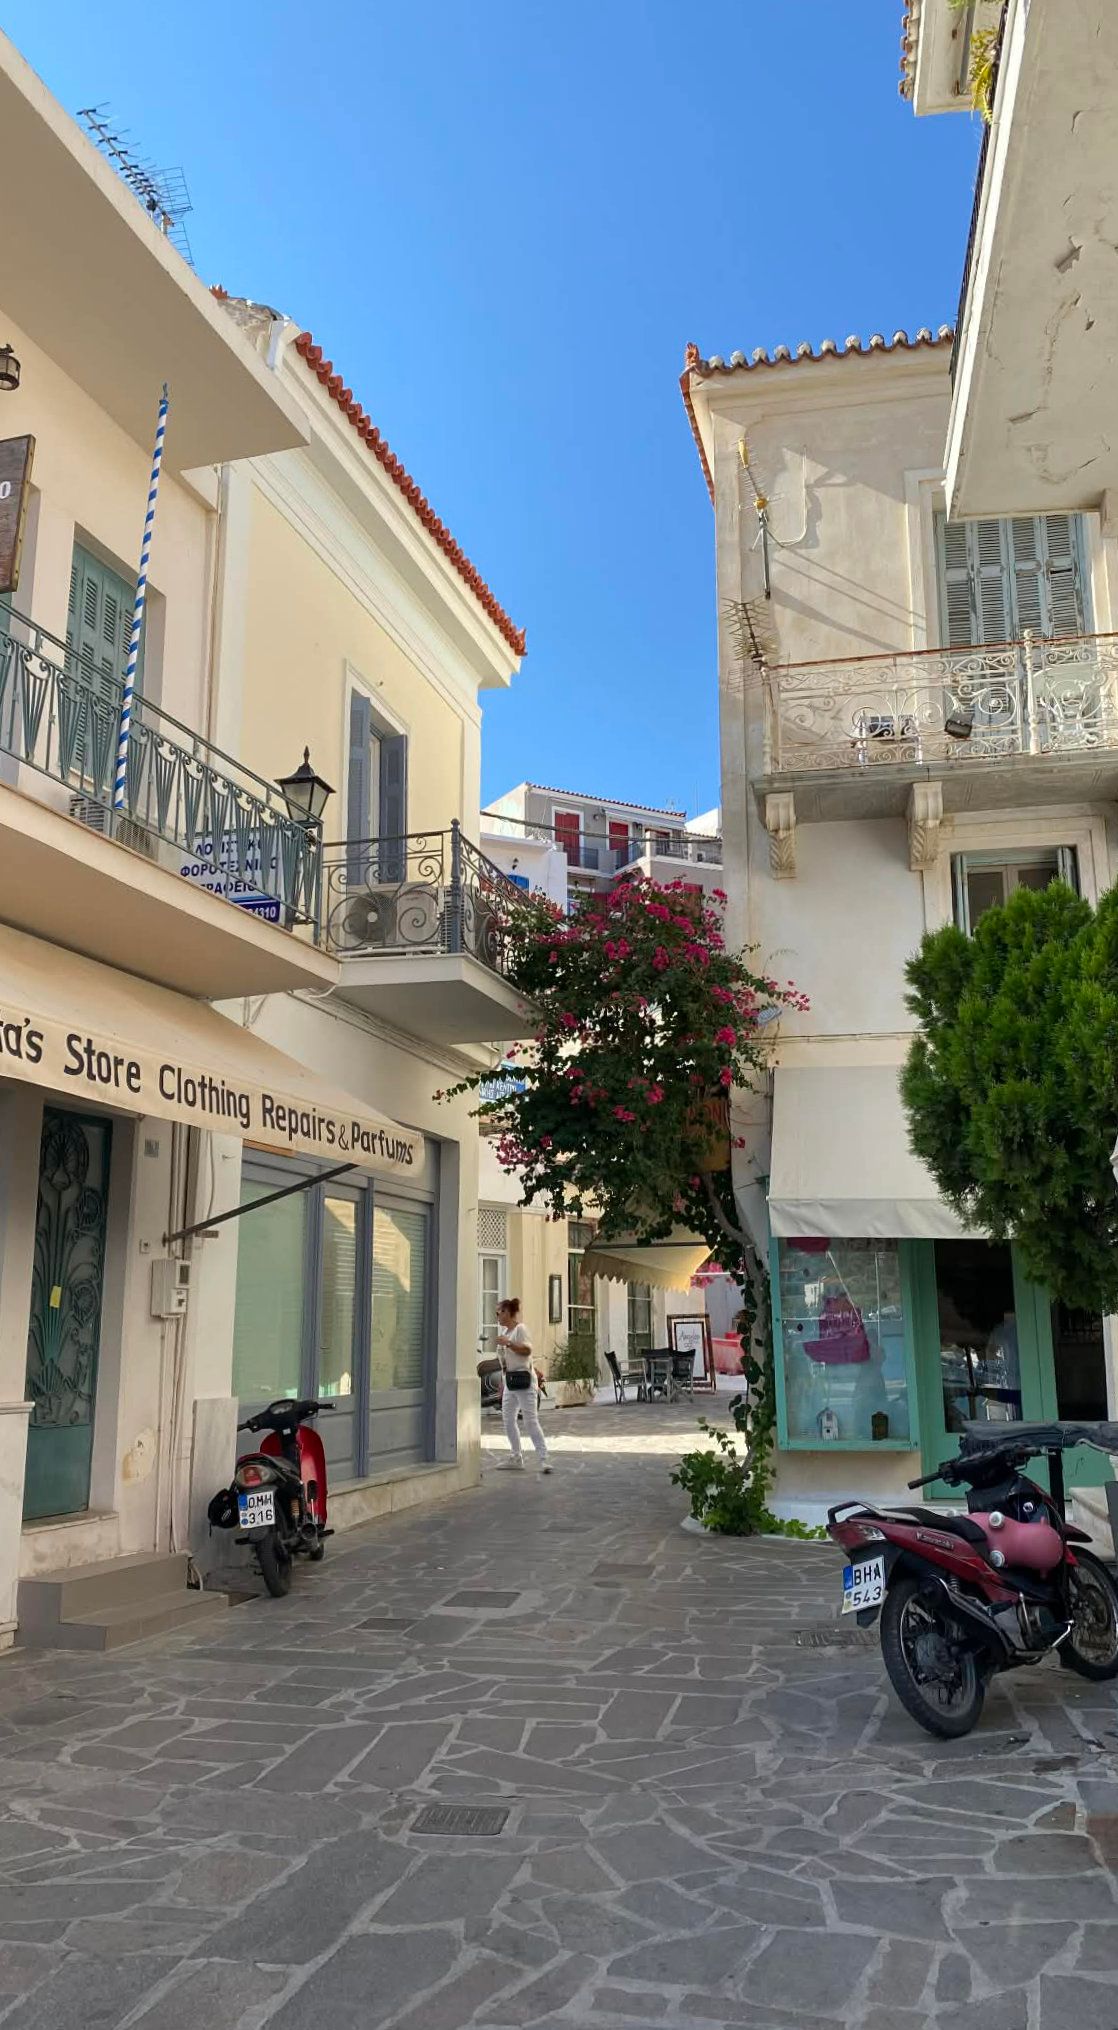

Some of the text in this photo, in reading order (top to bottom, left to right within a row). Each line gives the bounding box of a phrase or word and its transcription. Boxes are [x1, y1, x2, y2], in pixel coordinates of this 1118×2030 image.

[0, 1017, 414, 1166] a's Store Clothing Repairs & Parfums
[249, 1509, 273, 1524] 316
[852, 1586, 882, 1607] 543
